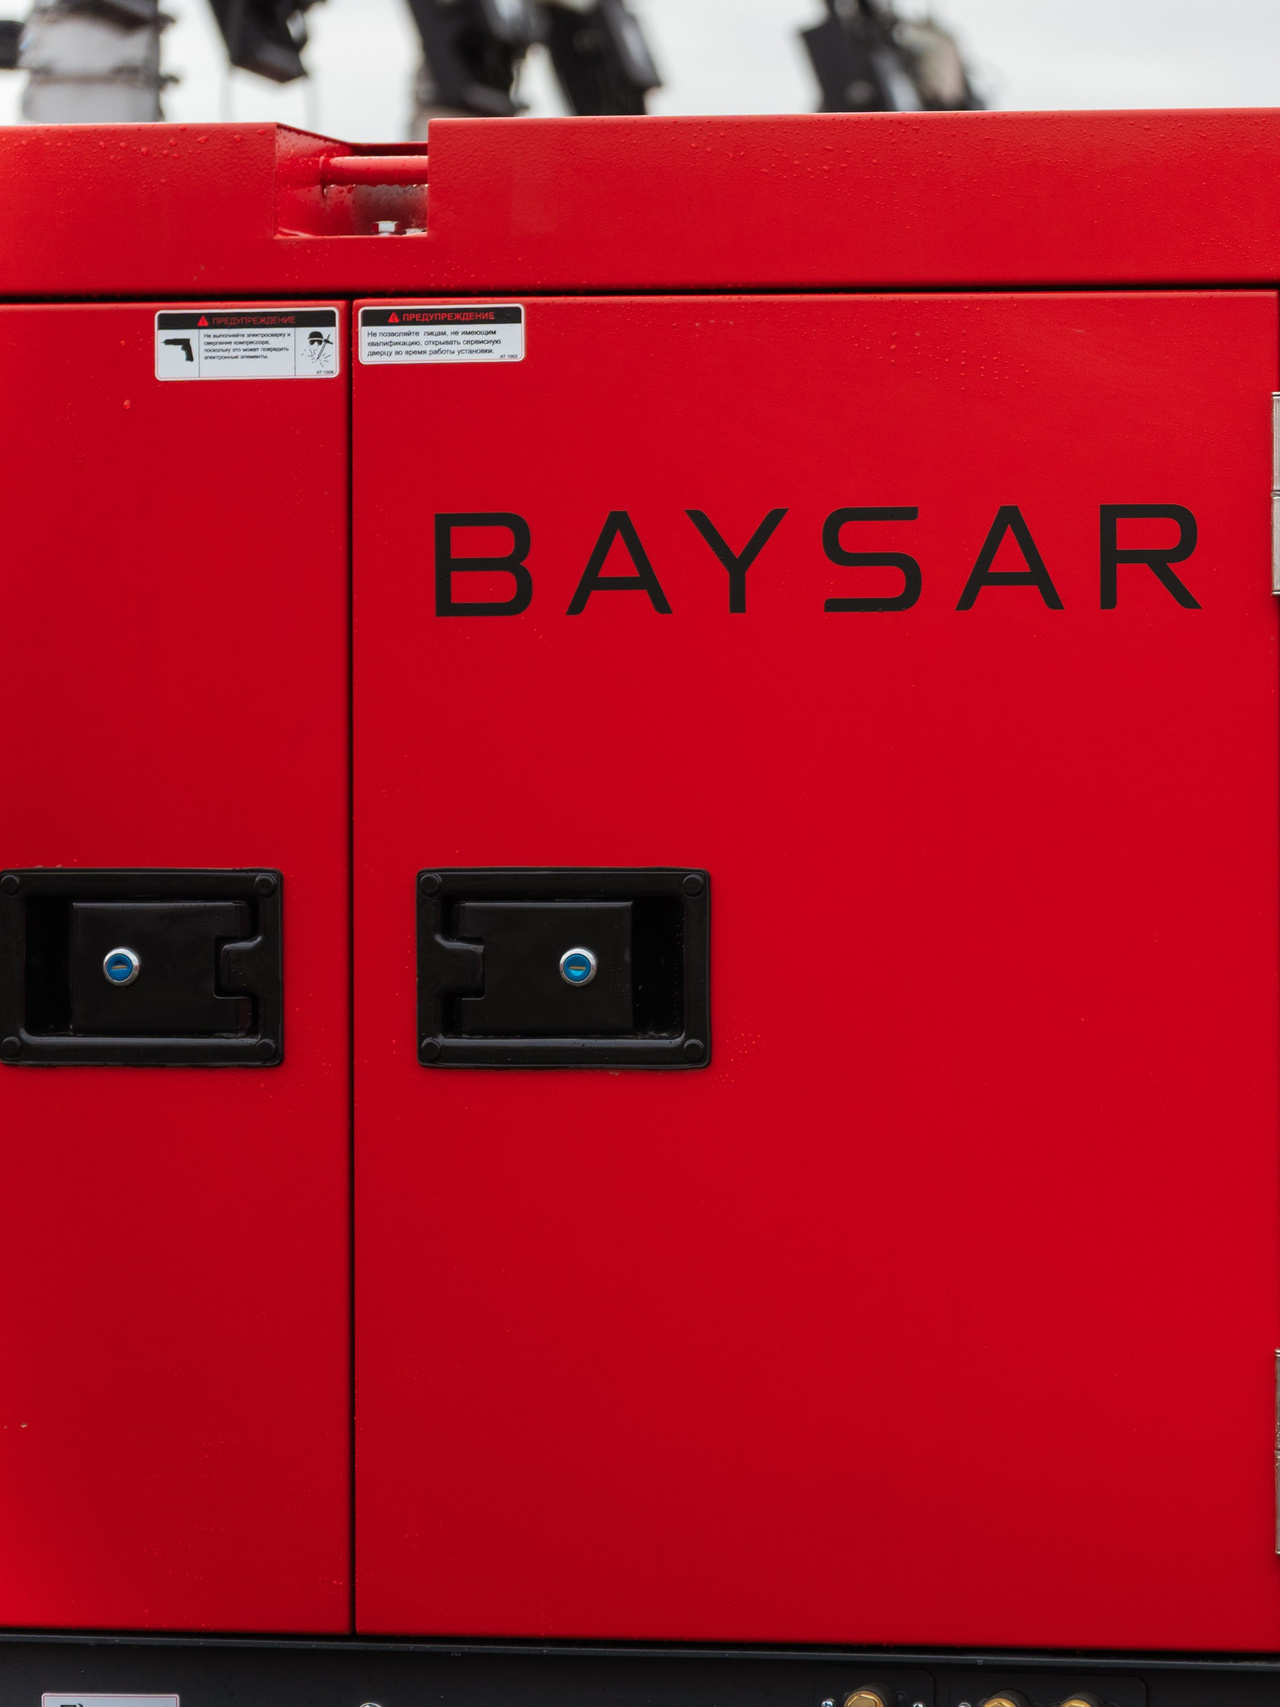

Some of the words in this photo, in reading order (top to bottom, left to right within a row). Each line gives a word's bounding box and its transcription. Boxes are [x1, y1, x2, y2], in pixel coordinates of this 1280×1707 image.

[212, 315, 296, 326] ПРЕДУПРЕЖДЕНИЕ
[402, 311, 495, 322] ПРЕДУПРЕЖДЕНИЕ
[367, 330, 377, 338] Не
[378, 330, 420, 338] позволяйте
[367, 340, 423, 348] квалификацию,
[424, 339, 461, 347] открывать
[367, 350, 393, 358] дверцу
[404, 349, 427, 357] время
[428, 348, 455, 356] работы
[456, 348, 495, 356] установки.
[435, 504, 1202, 618] BAYSAR
